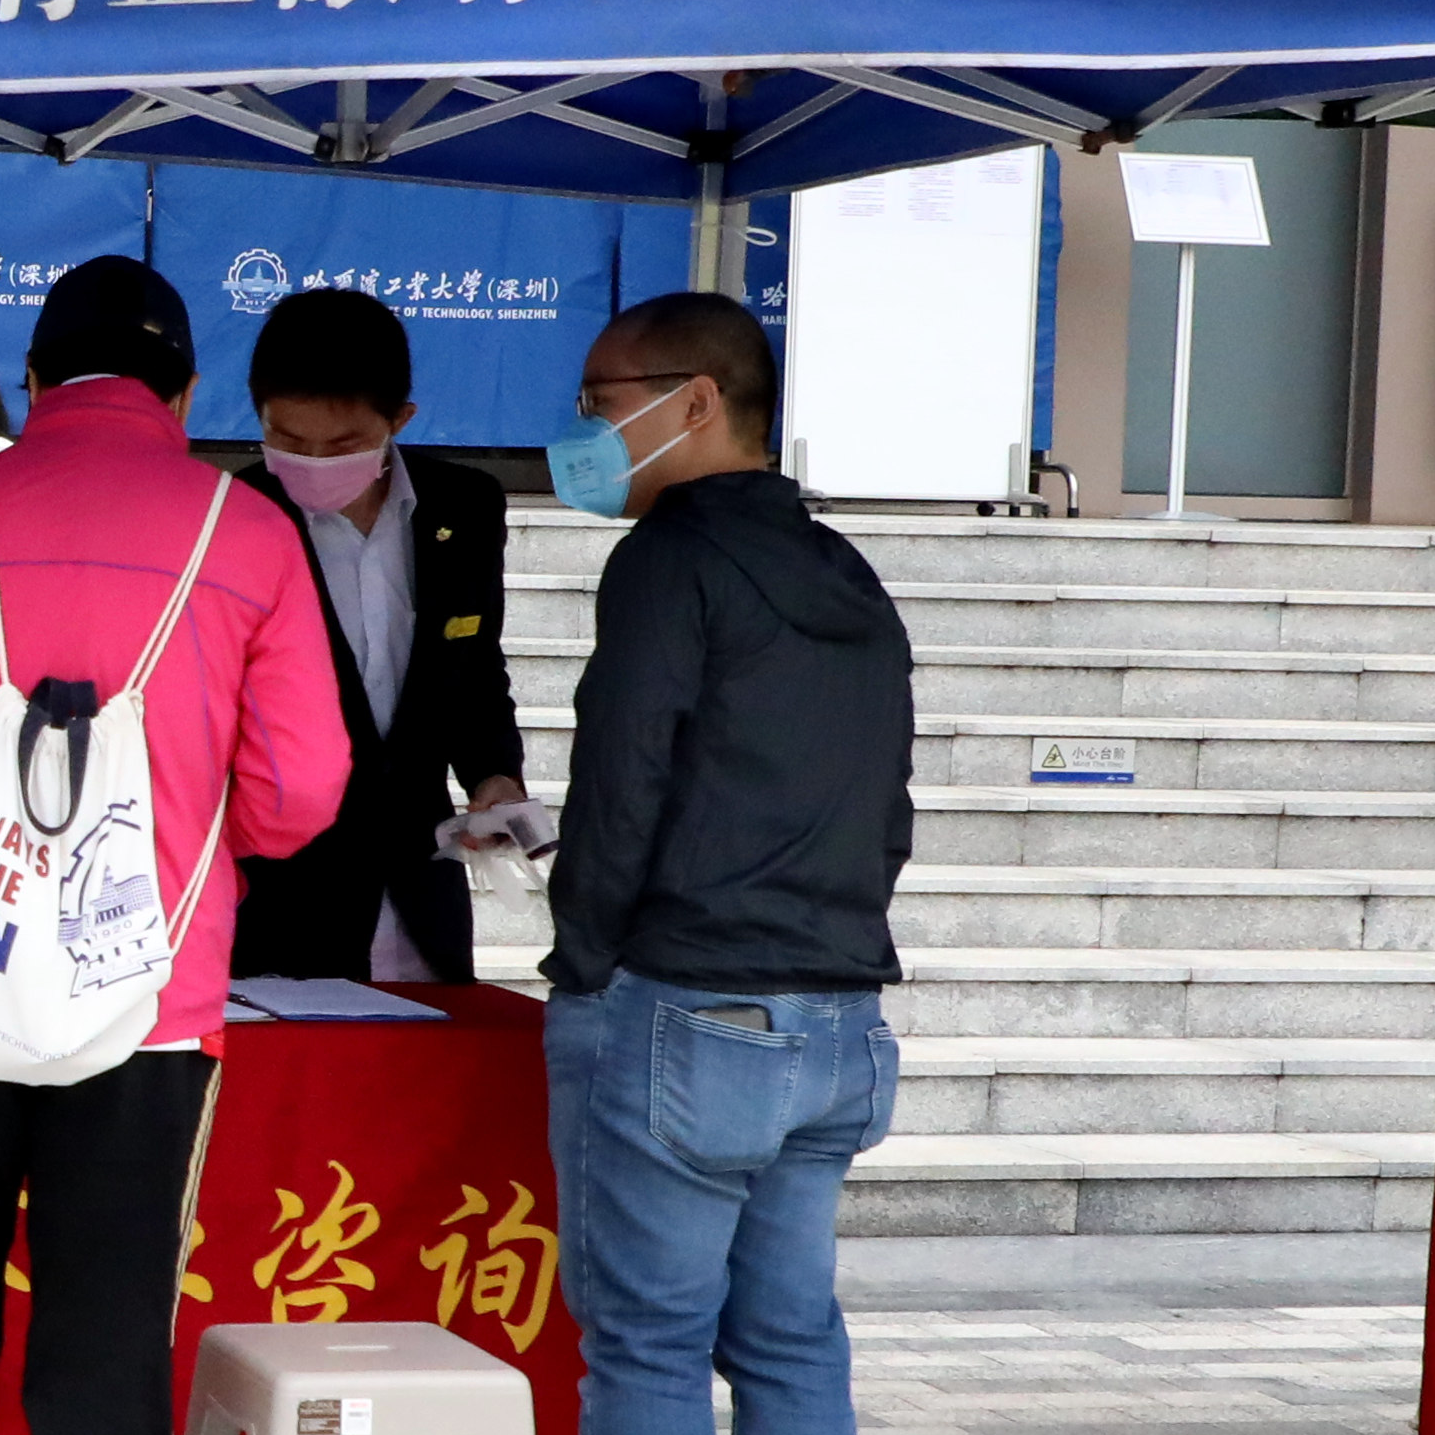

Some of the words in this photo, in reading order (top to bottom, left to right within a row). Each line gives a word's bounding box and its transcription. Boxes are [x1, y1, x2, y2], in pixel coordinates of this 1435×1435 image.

[19, 294, 48, 306] SHEN
[404, 306, 417, 318] OF
[497, 308, 557, 320] SHENZHEN
[1072, 746, 1126, 760] 小心台阶
